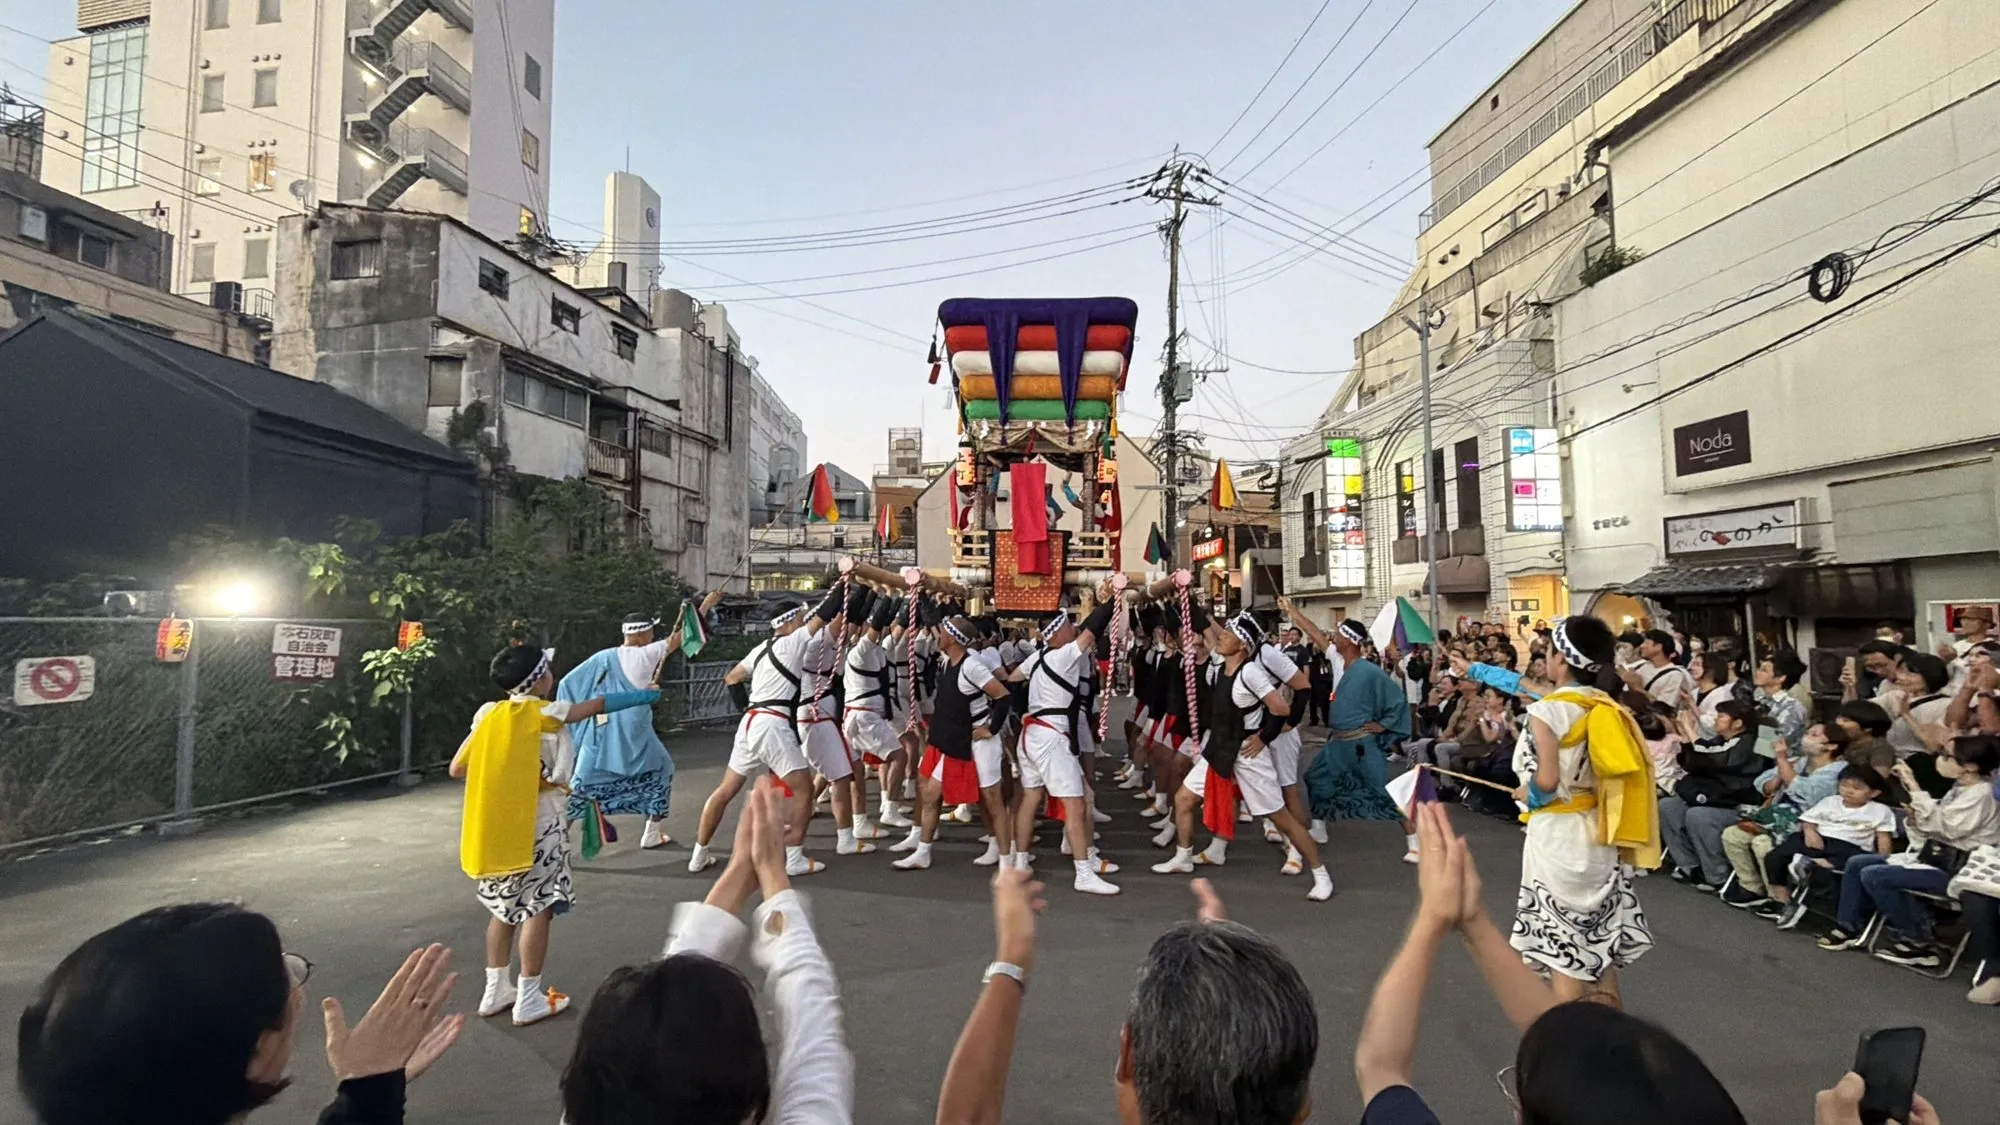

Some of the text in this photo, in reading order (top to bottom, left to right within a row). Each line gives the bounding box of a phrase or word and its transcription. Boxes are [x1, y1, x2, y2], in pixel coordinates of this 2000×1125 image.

[1690, 428, 1732, 454] Noda
[287, 640, 328, 653] 自治会
[275, 655, 335, 678] 管理地
